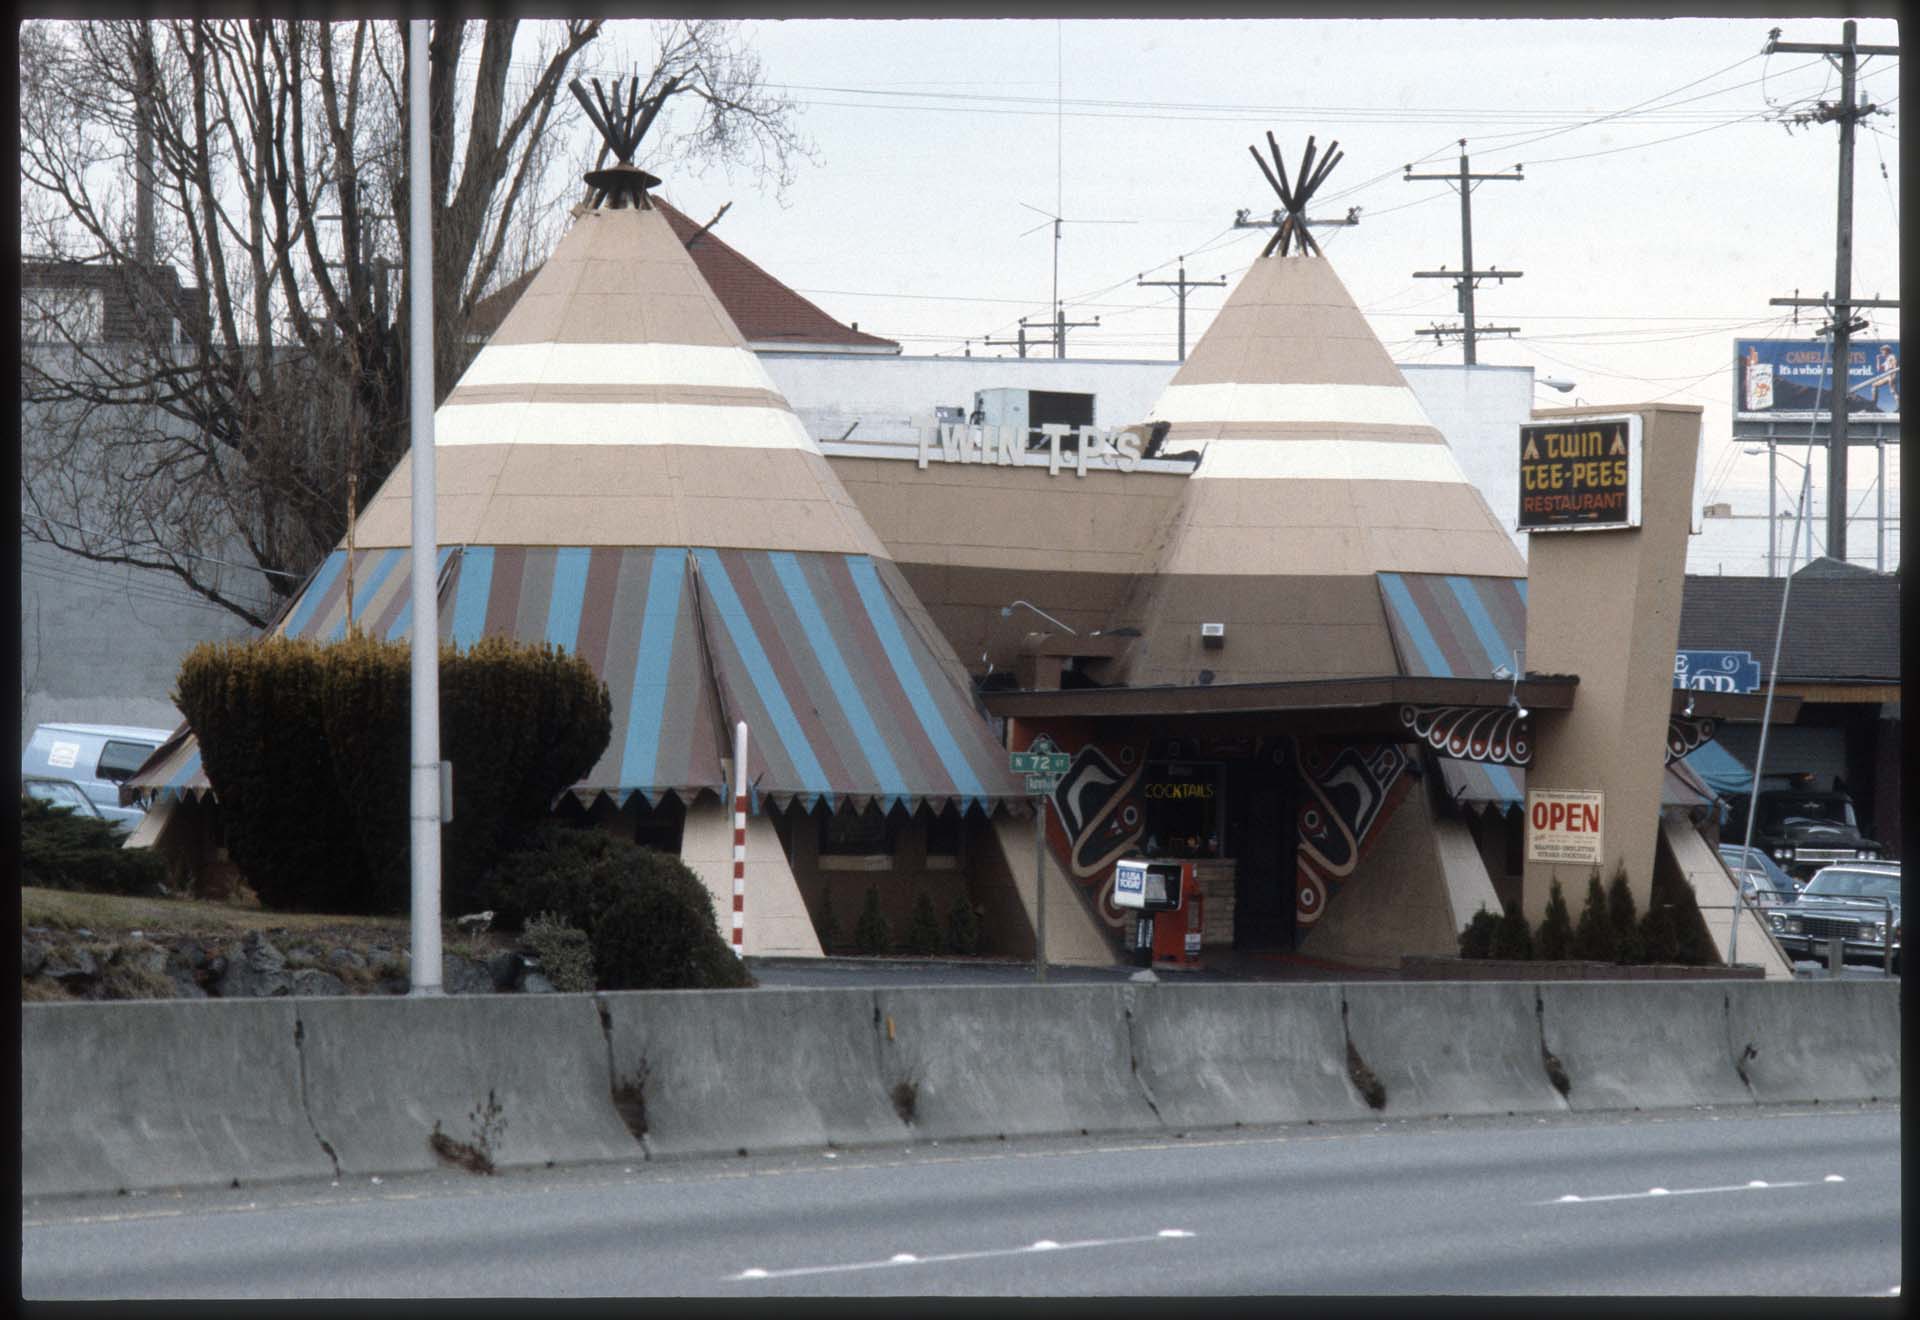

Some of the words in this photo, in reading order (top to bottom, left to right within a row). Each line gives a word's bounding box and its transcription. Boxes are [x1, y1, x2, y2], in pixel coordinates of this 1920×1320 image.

[913, 419, 1025, 468] TWIN
[1522, 461, 1627, 490] TEE-PEES
[1524, 492, 1626, 513] RESTAURANT
[1015, 757, 1024, 768] N
[1030, 756, 1050, 770] 72
[1144, 784, 1214, 799] COCKTAILS
[1532, 801, 1600, 833] OPEN
[1127, 870, 1141, 880] USA
[1119, 879, 1141, 890] TODAY
